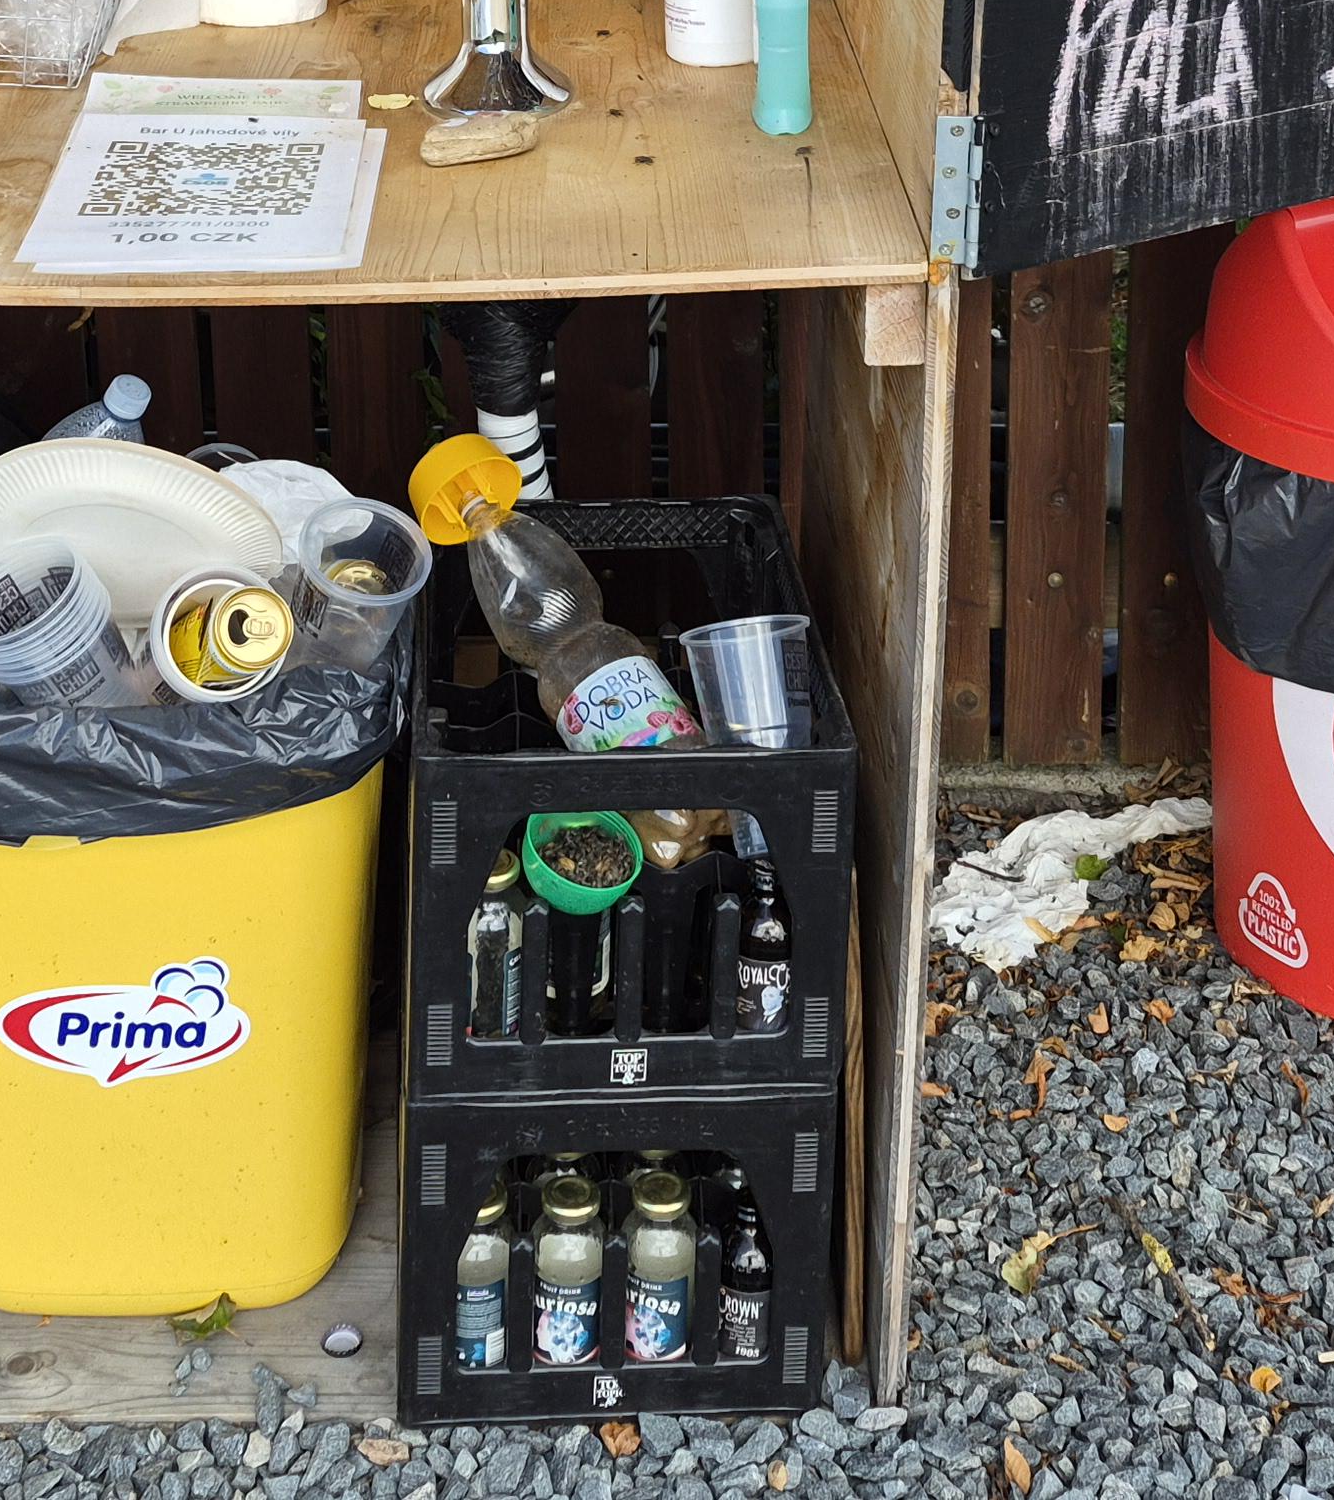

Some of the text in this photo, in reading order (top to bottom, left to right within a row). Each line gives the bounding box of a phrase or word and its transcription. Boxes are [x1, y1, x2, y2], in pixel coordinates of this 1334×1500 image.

[139, 126, 168, 135] Bar
[173, 127, 186, 135] U
[190, 125, 268, 137] jahodové
[111, 232, 260, 245] 1,00 CZK
[574, 662, 652, 725] DOBRÁ
[589, 686, 660, 731] VODA
[1251, 898, 1292, 932] RECYCLED
[57, 1011, 207, 1049] Prima
[615, 1052, 643, 1065] TOP
[613, 1063, 644, 1074] TOPIC
[535, 1293, 598, 1317] uriosa
[725, 1312, 749, 1326] Cola
